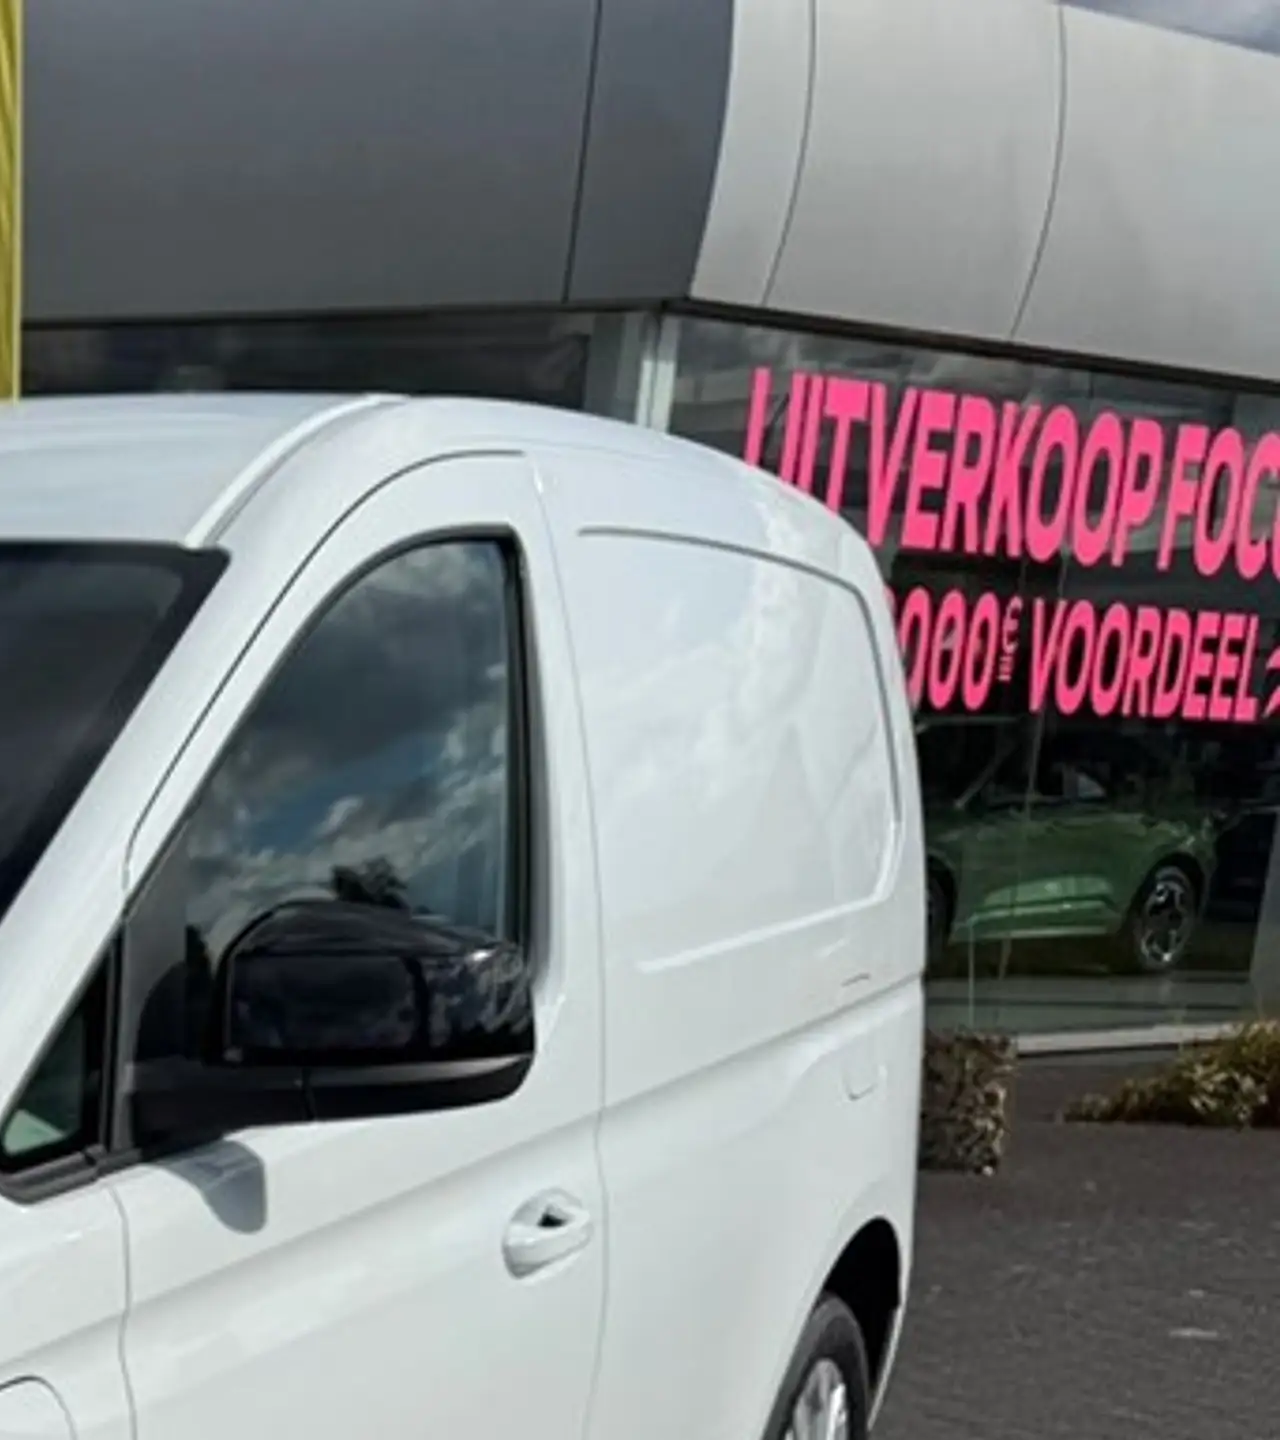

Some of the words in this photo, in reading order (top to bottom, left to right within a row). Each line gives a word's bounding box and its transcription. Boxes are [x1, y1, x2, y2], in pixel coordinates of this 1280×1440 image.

[744, 366, 1165, 566] UITVERKOOP
[1157, 423, 1280, 582] FOC
[1028, 598, 1260, 723] VOORDEEL
